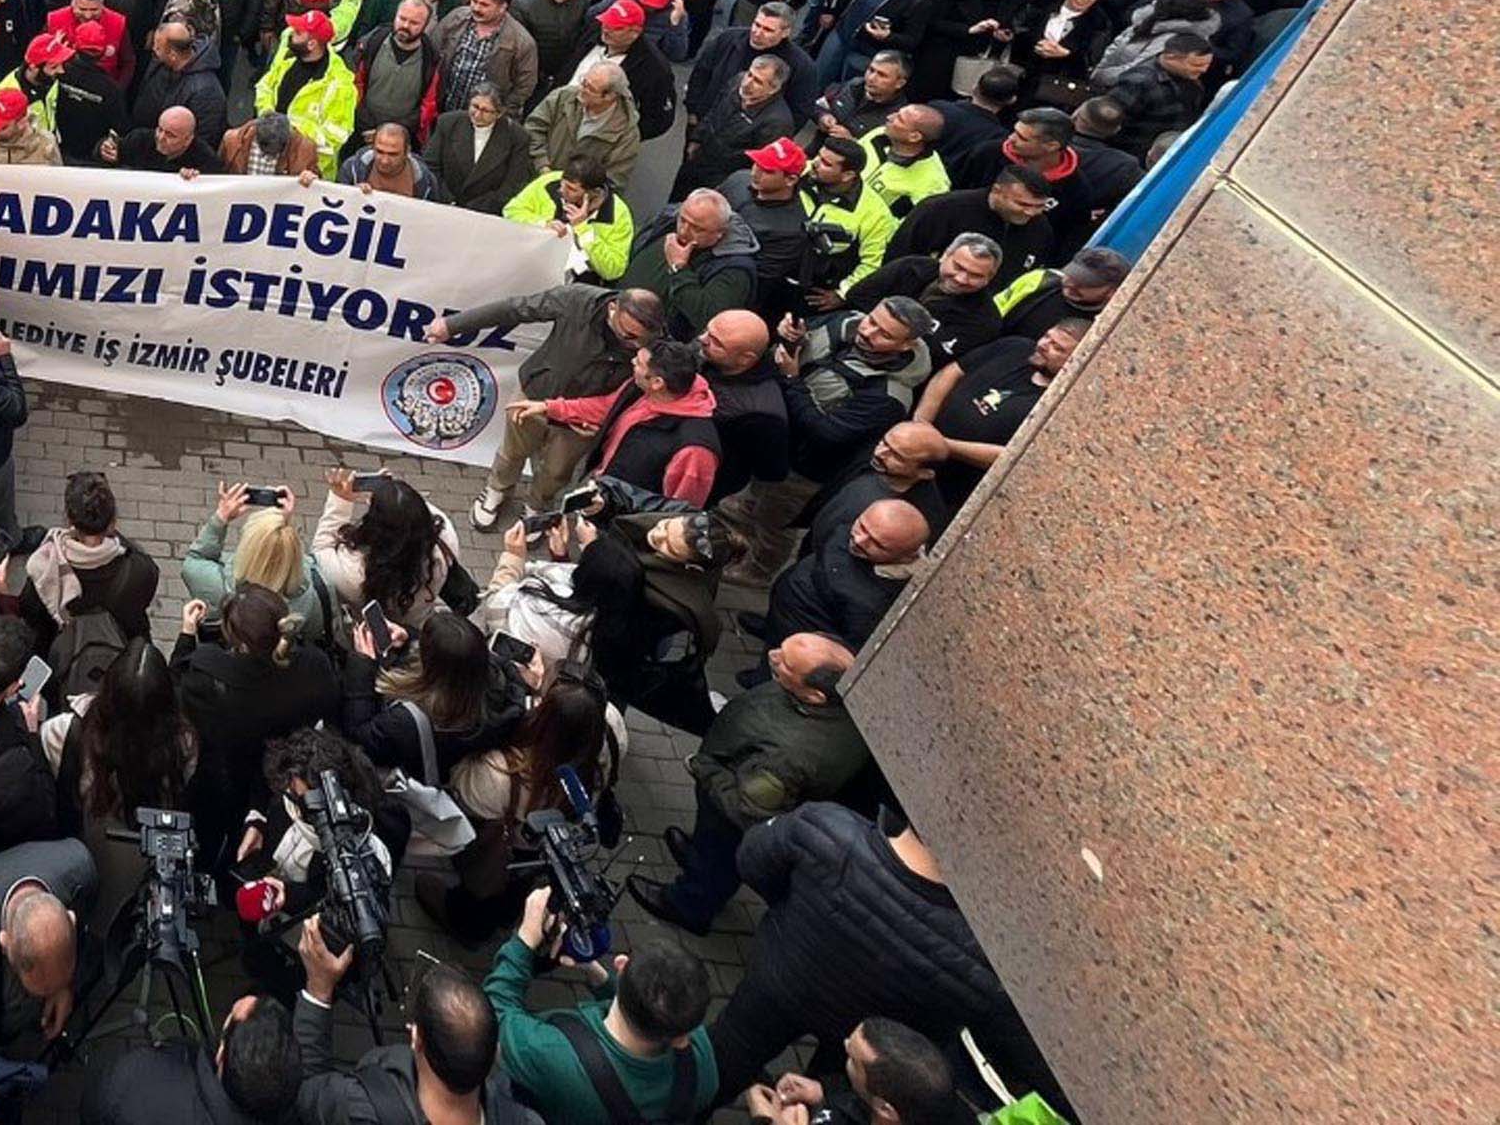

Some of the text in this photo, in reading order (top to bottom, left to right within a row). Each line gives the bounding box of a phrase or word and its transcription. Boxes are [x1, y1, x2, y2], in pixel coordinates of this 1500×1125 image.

[223, 196, 406, 269] DEĞİL
[95, 330, 122, 367] İŞ
[127, 333, 211, 374] İZMİR
[215, 349, 350, 399] ŞUBELERİ
